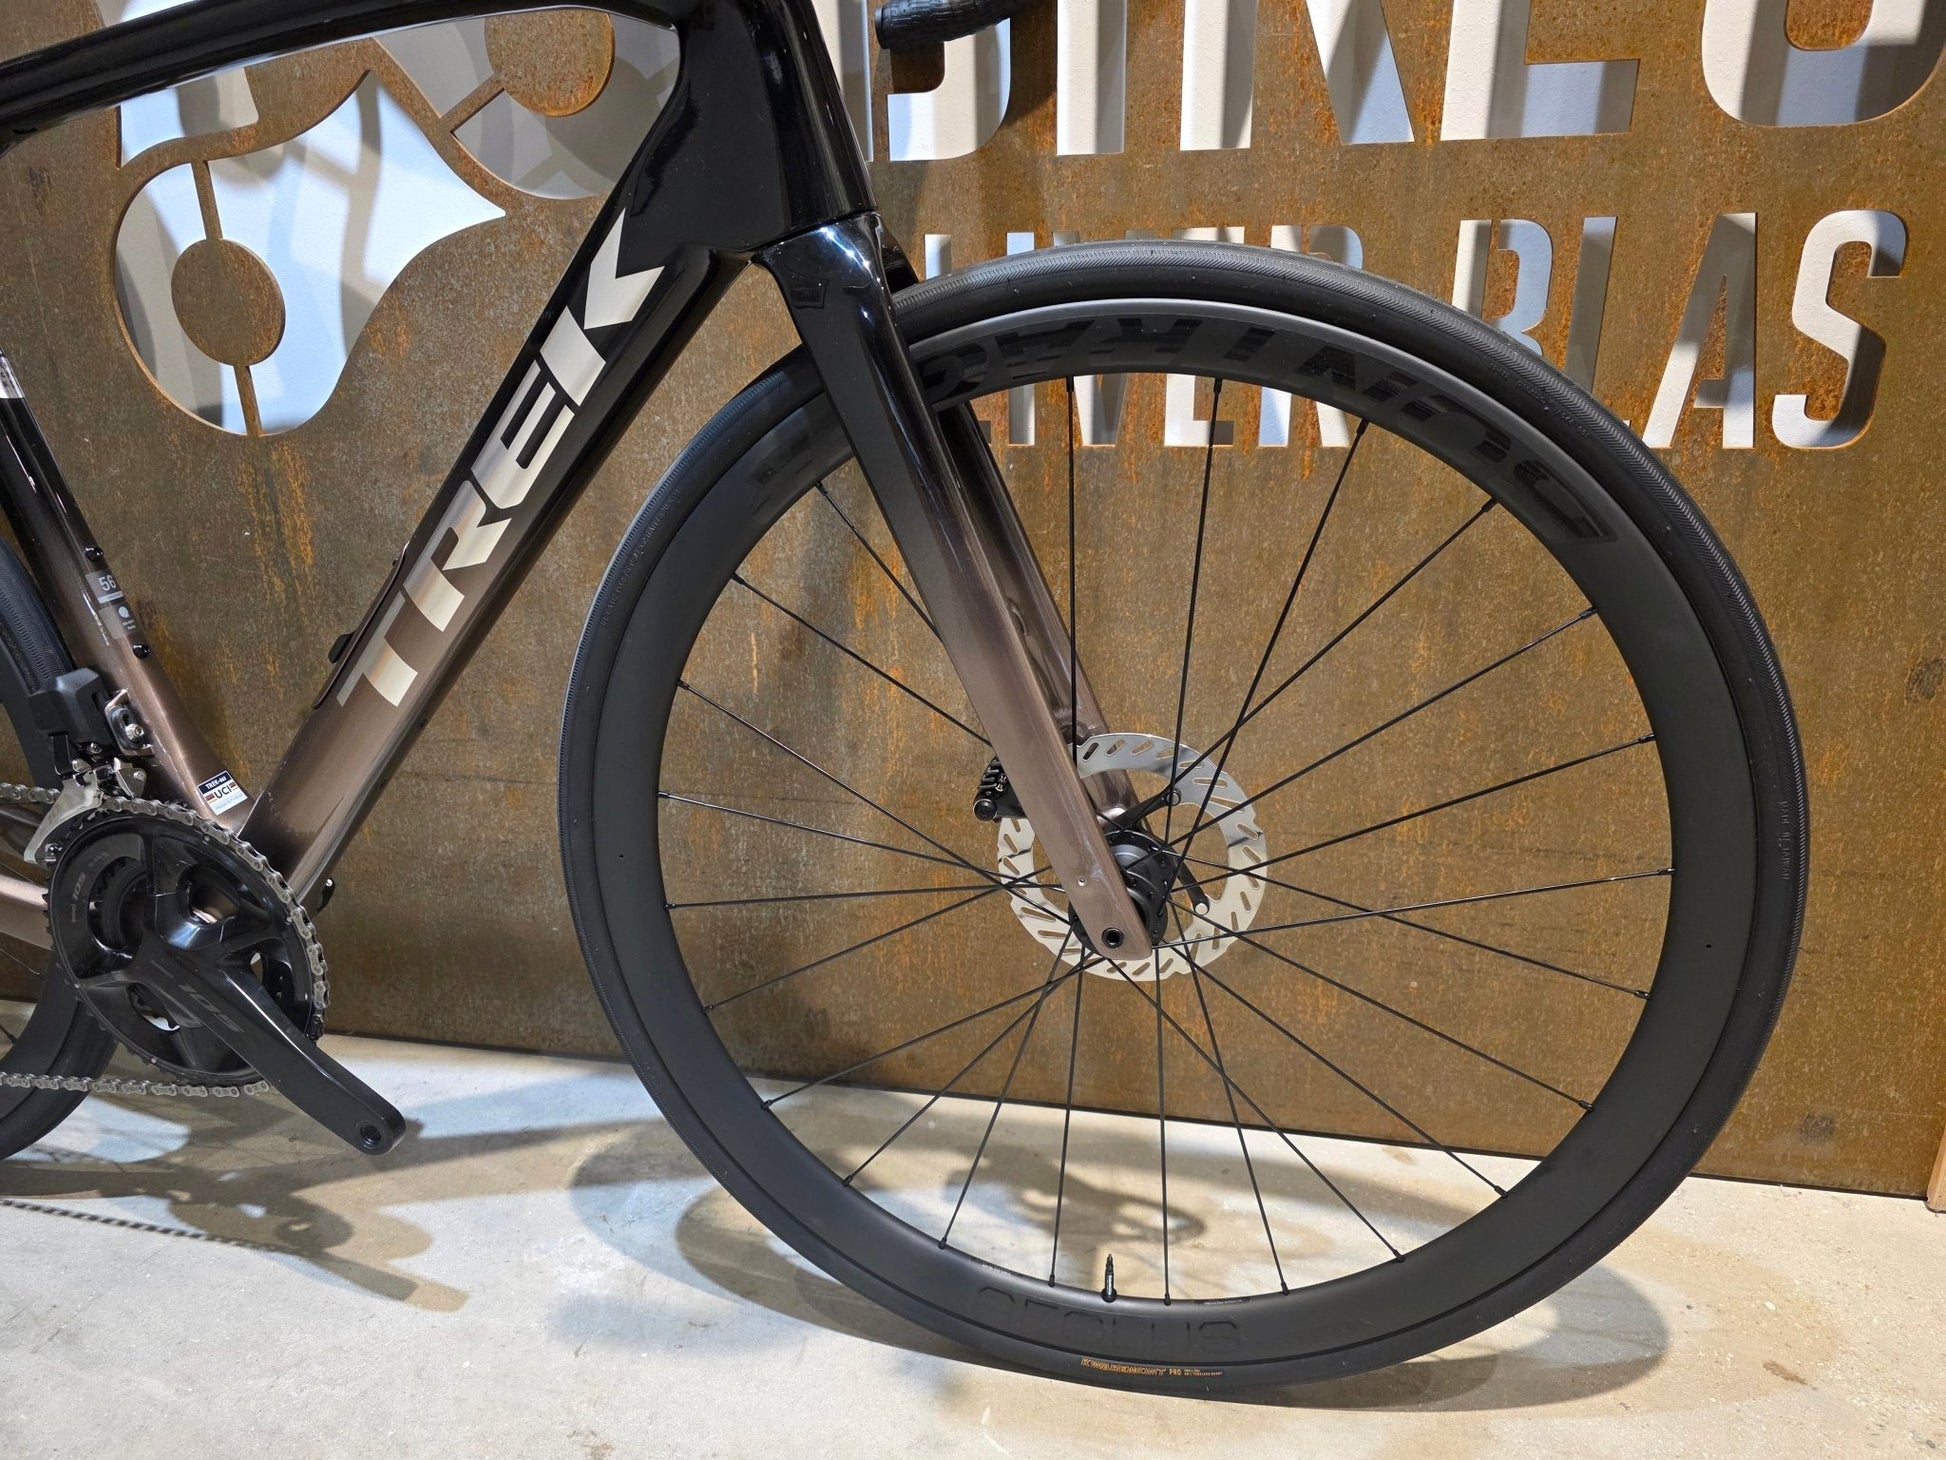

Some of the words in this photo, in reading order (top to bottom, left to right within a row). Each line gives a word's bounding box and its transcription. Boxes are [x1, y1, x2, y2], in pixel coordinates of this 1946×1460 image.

[337, 208, 665, 707] TREK
[98, 574, 117, 592] 56
[214, 785, 232, 799] UCI
[177, 983, 245, 1033] 105
